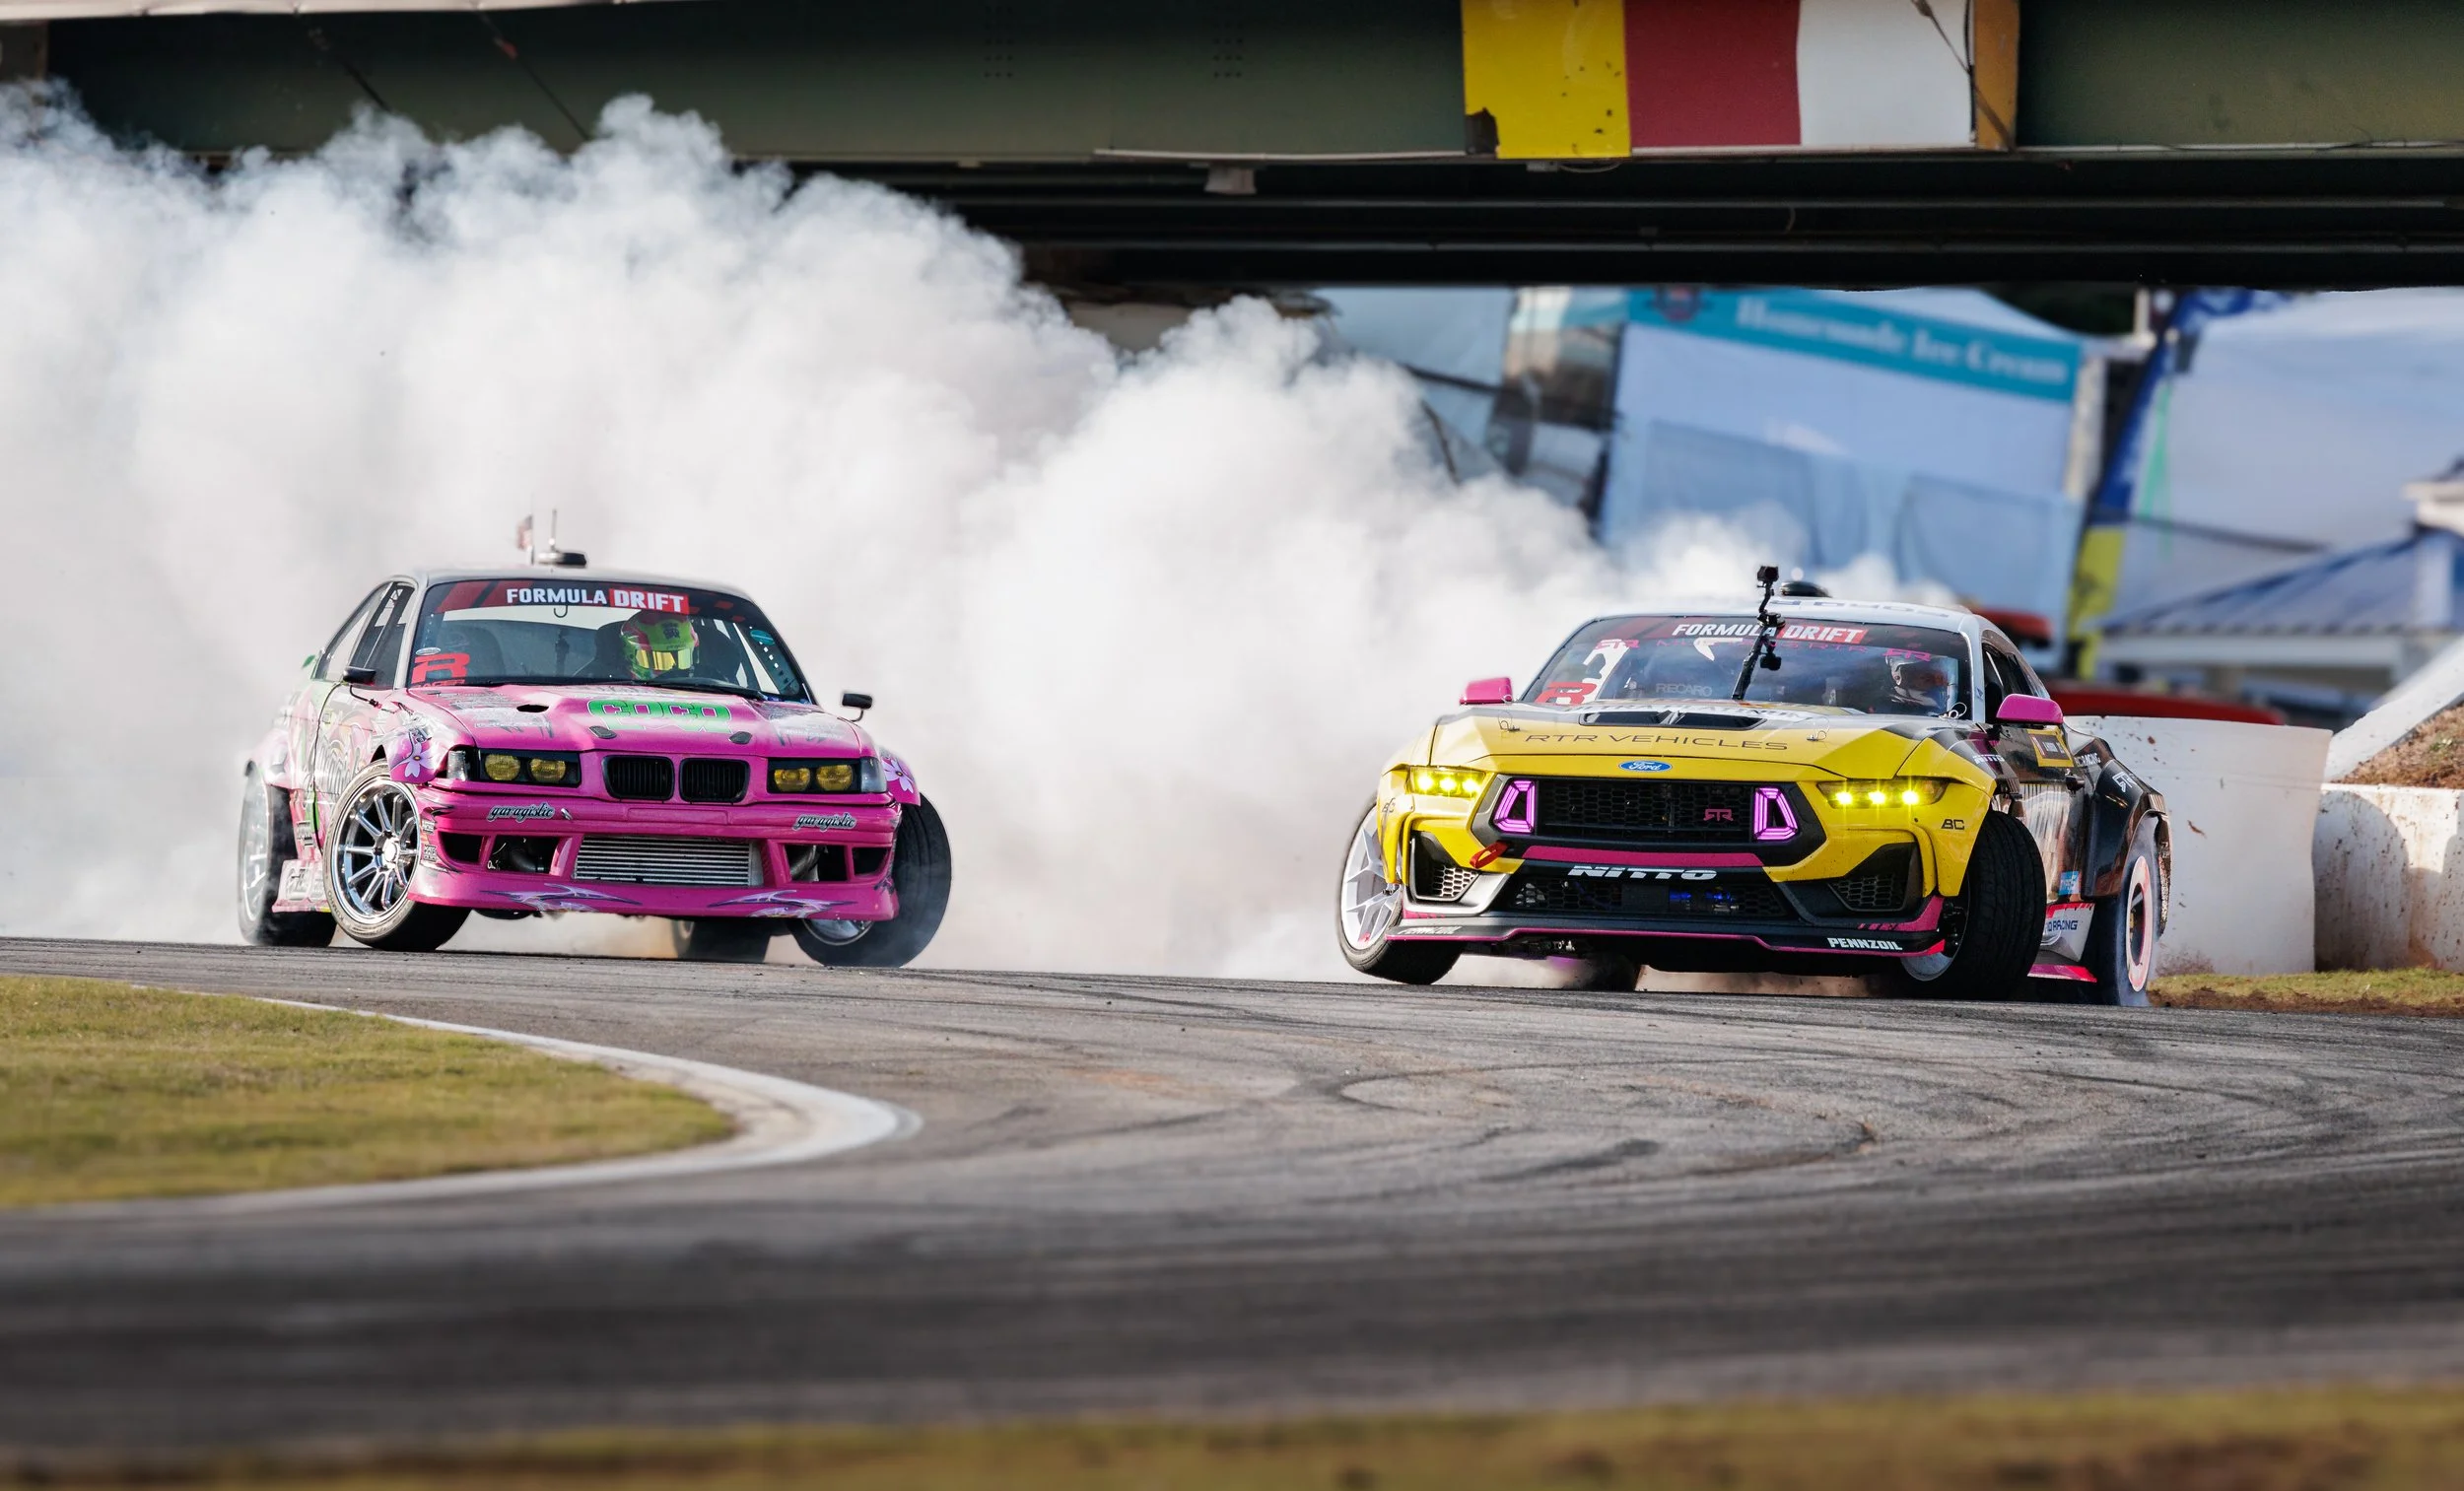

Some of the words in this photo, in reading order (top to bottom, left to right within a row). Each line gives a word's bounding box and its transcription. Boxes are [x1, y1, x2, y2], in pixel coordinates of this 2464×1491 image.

[507, 587, 608, 605] FORMULA
[613, 590, 685, 612] DRIFT
[1672, 623, 1776, 638] FORMULA
[1783, 625, 1865, 644] DRIFT
[1656, 683, 1713, 697] RECARO
[586, 698, 732, 730] COCO
[1526, 733, 1599, 742] RTR
[1608, 734, 1788, 751] VEHICLES
[1626, 760, 1664, 772] Ford
[487, 803, 555, 823] garagistic
[792, 812, 856, 832] garagistic
[1941, 819, 1965, 831] BC
[1568, 865, 1717, 881] NITTO
[1826, 937, 1903, 951] PENNZOIL
